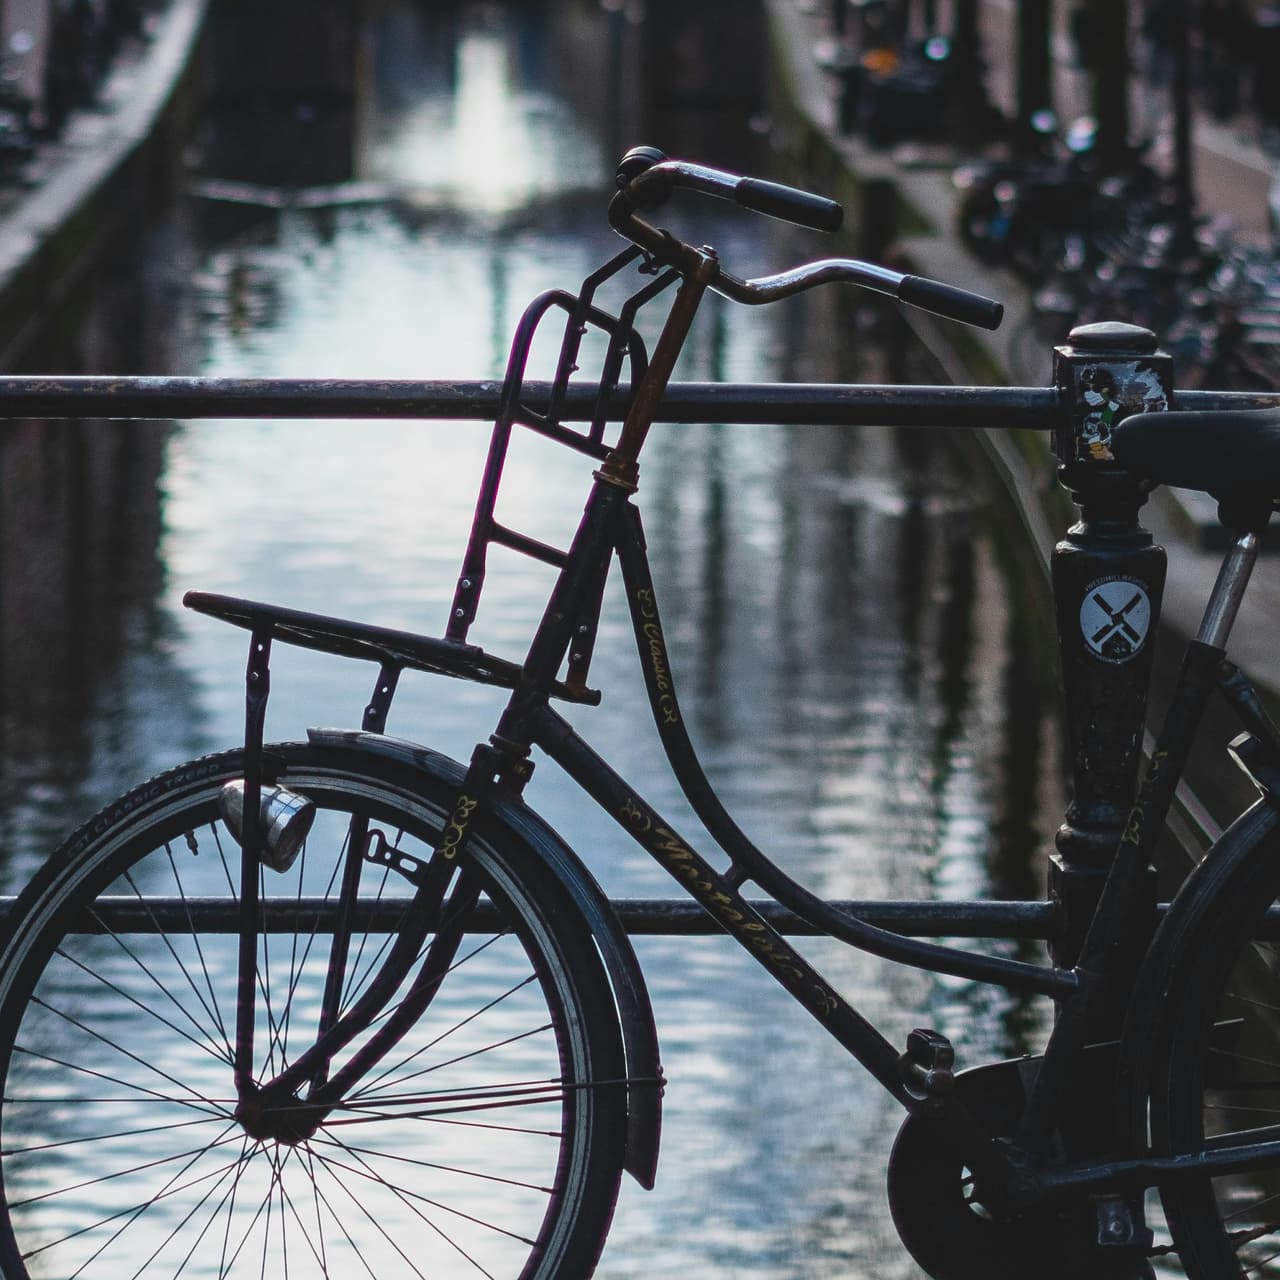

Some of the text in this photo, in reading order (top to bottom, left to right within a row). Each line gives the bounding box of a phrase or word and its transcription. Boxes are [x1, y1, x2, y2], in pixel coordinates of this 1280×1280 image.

[644, 623, 669, 691] Classic
[94, 786, 161, 833] CLASSIC
[165, 763, 220, 787] TREND
